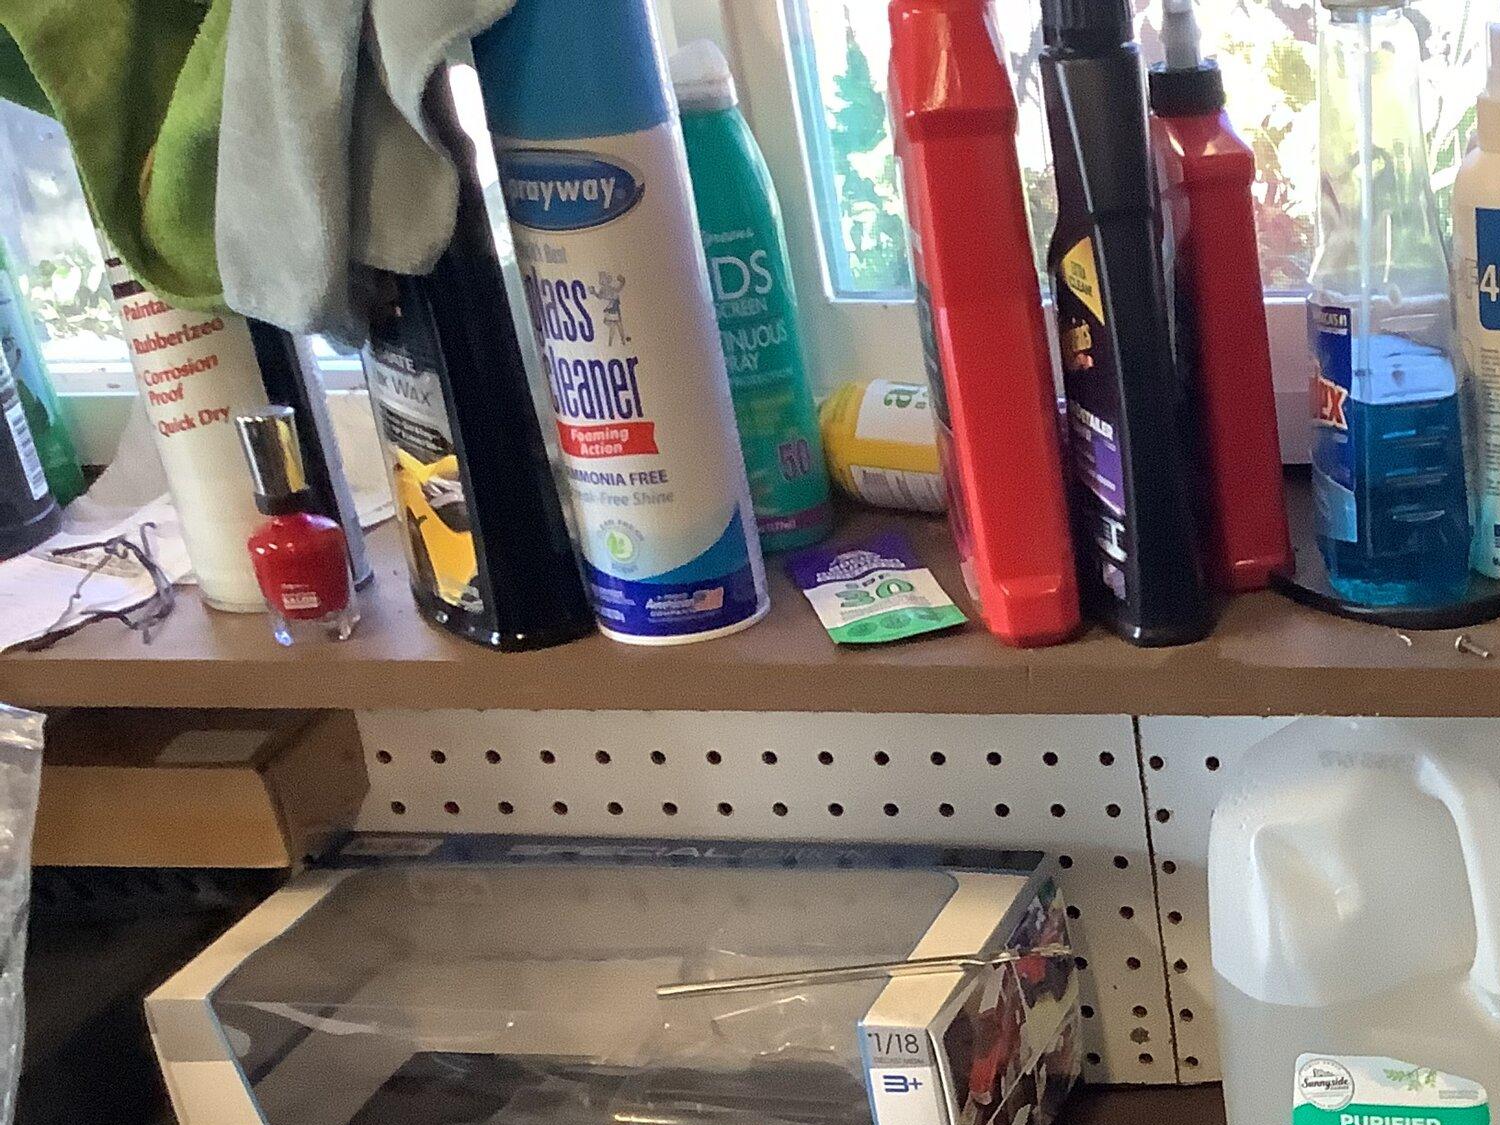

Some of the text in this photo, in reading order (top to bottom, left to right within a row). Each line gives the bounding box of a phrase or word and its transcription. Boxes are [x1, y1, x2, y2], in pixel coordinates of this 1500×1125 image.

[508, 177, 616, 212] prayway
[711, 249, 773, 300] DS
[122, 299, 175, 321] Painta
[132, 316, 225, 355] Rubberized
[143, 354, 219, 387] Corrosion
[148, 382, 185, 406] Proof
[157, 406, 231, 438] Quick Dry
[570, 427, 629, 443] Foaming
[579, 442, 623, 456] Action
[629, 469, 668, 486] FREE
[835, 578, 914, 608] 30
[873, 1032, 920, 1055] 1/18
[882, 1074, 924, 1093] 3+
